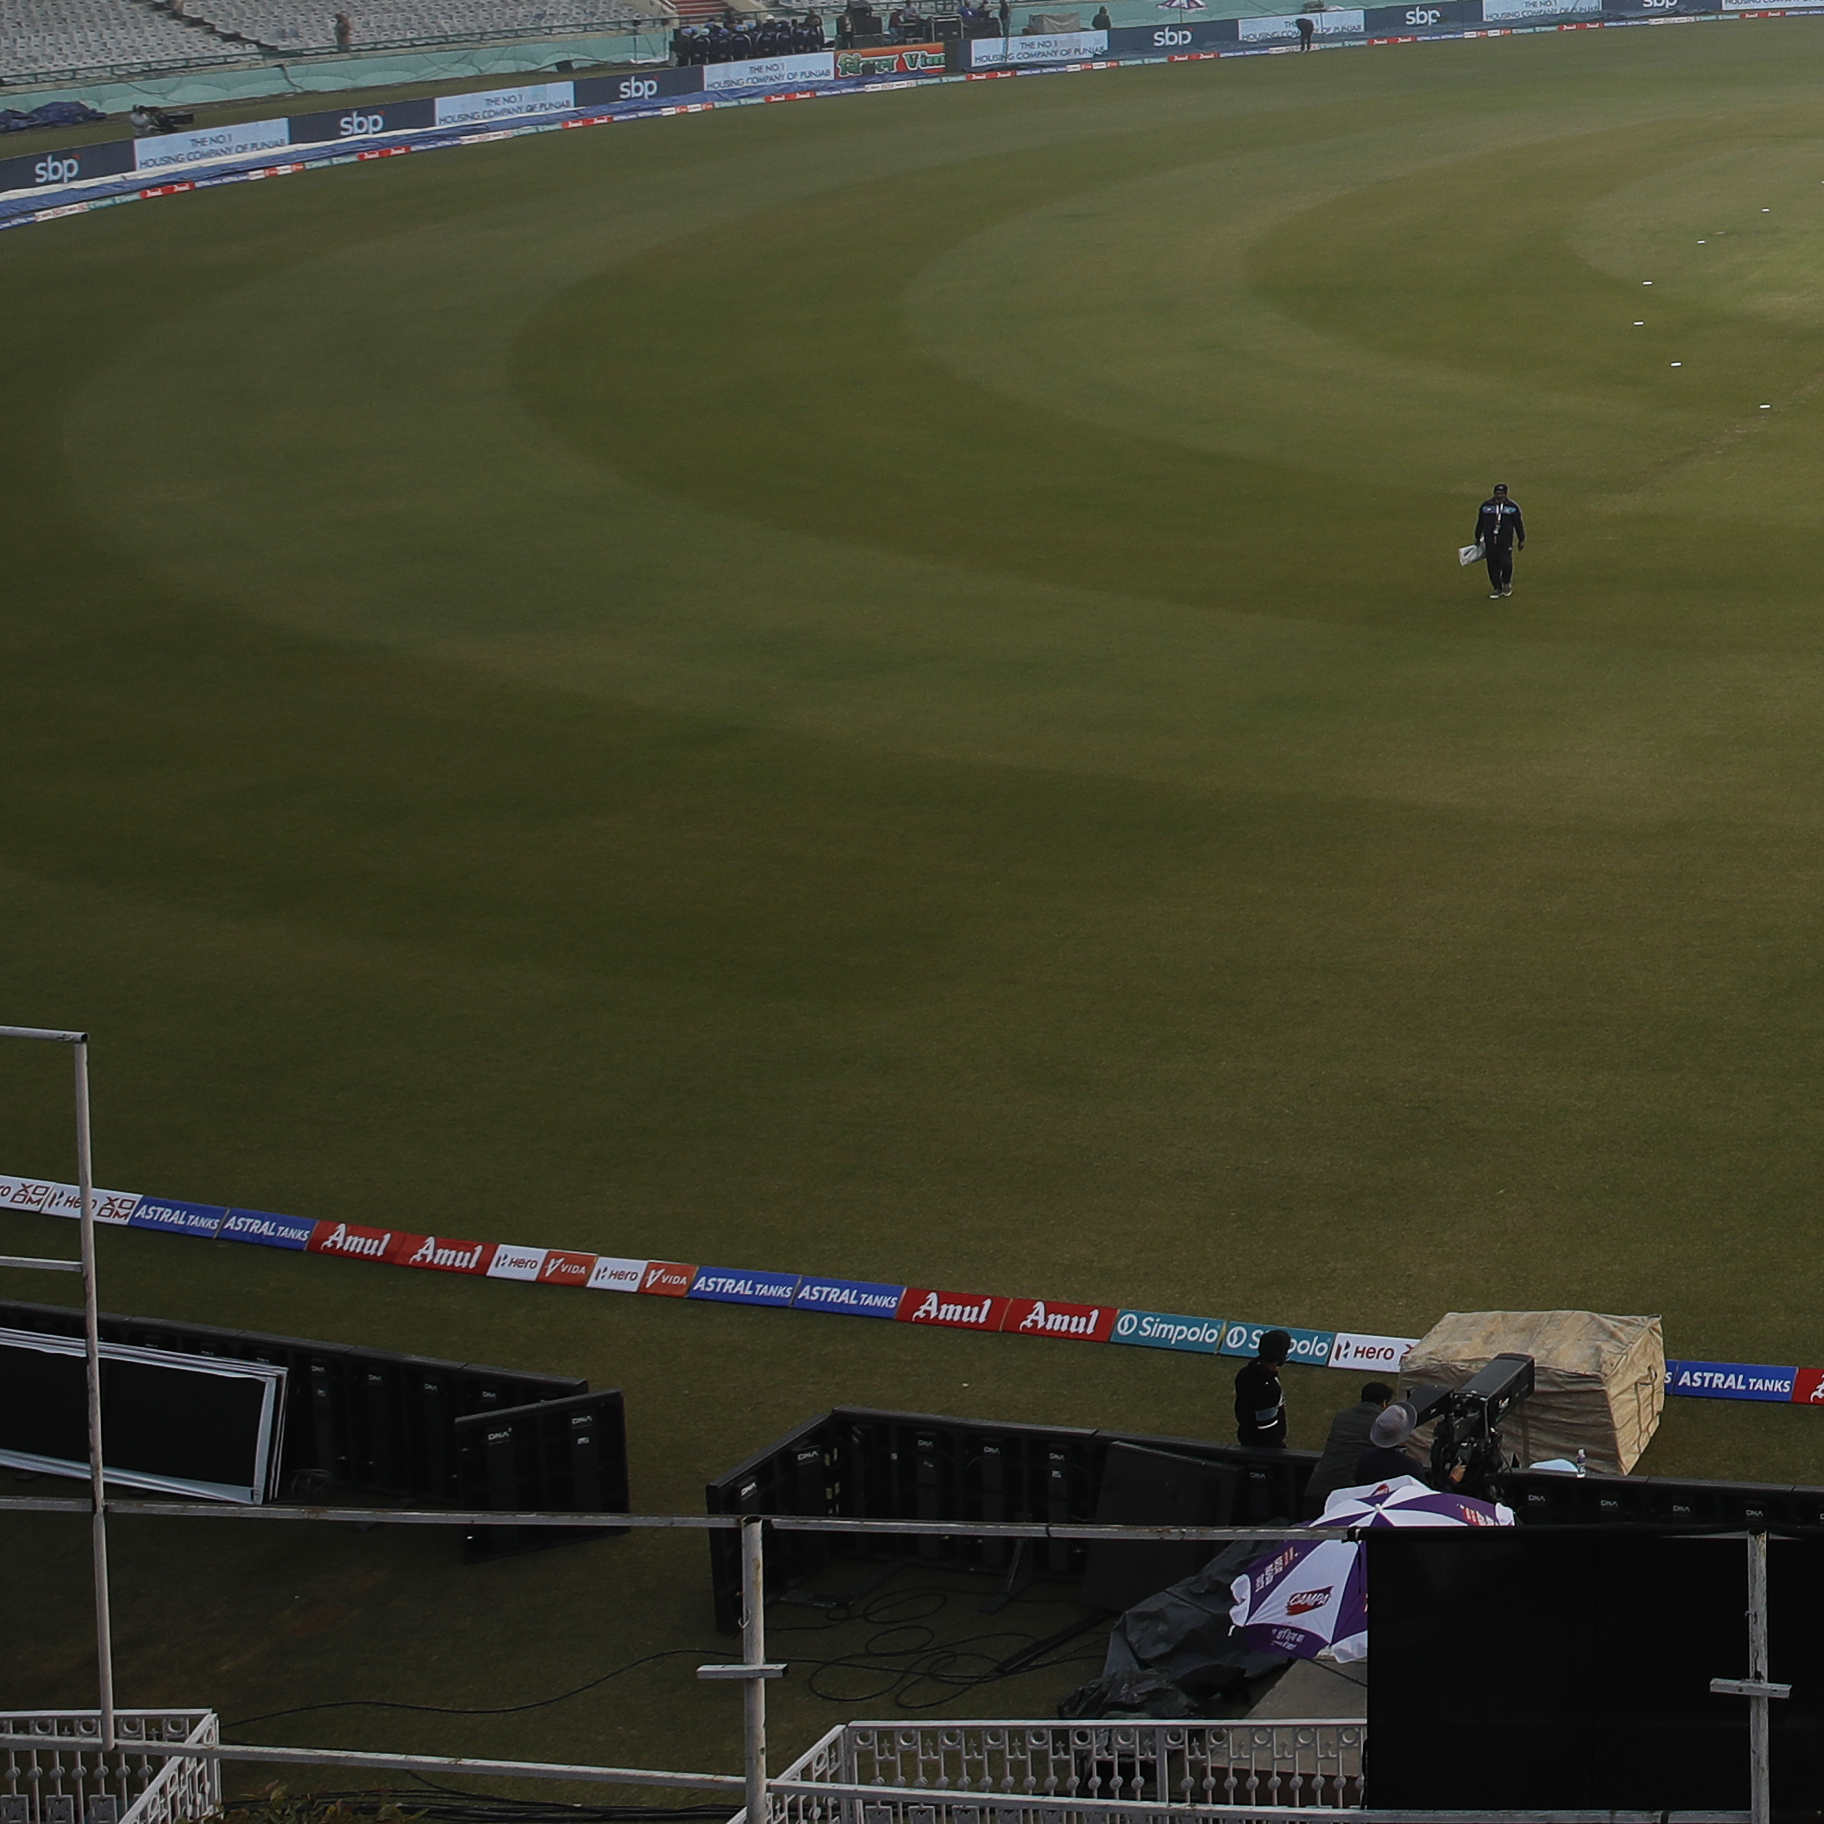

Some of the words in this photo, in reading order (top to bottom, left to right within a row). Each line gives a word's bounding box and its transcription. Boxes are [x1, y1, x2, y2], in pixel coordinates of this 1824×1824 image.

[619, 78, 659, 100] sbp
[35, 156, 79, 184] sbp
[135, 1204, 187, 1226] ASTRAL
[187, 1214, 219, 1230] TANKS
[323, 1223, 391, 1257] Amul
[507, 1257, 537, 1271] Hero
[561, 1263, 586, 1275] VIDA
[797, 1284, 858, 1306] ASTRAL
[859, 1294, 898, 1309] TANKS
[912, 1291, 993, 1325] Amul
[1138, 1316, 1217, 1345] Simpolo
[1678, 1371, 1747, 1391] ASTRAL
[1748, 1378, 1791, 1393] TANKS
